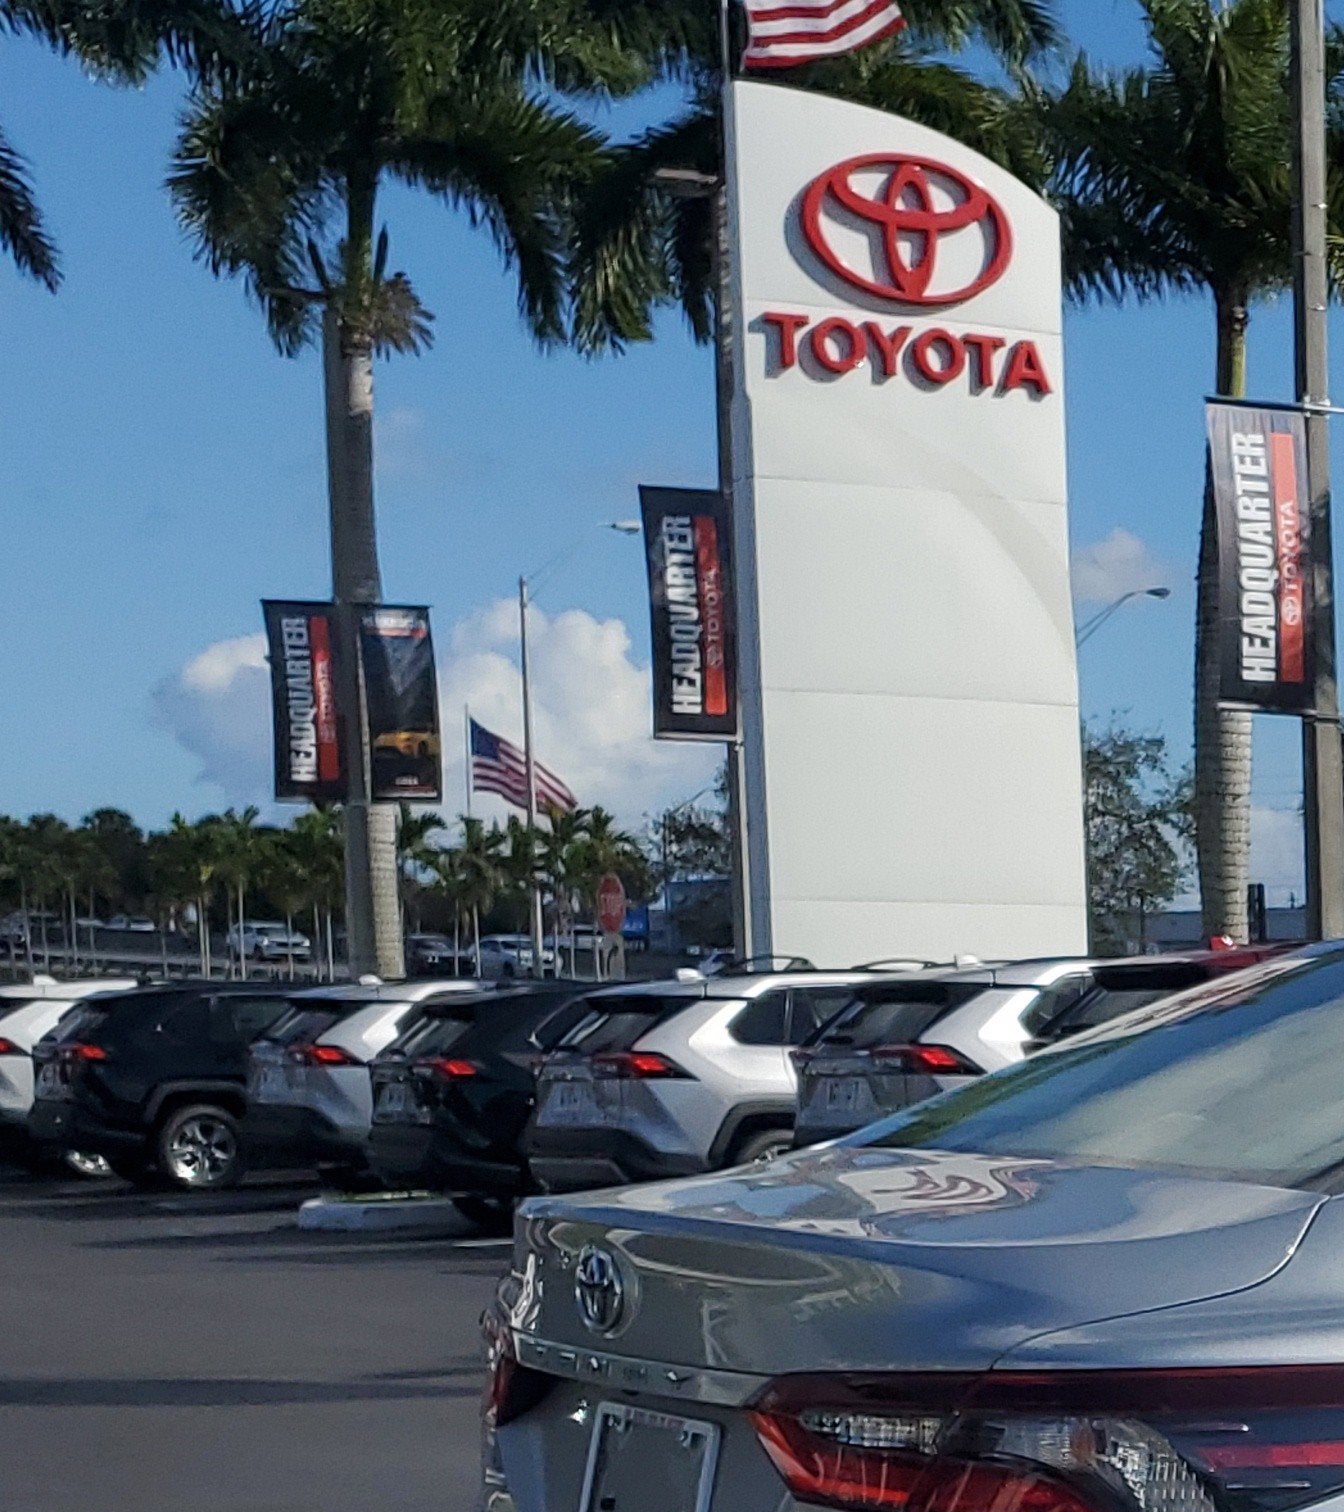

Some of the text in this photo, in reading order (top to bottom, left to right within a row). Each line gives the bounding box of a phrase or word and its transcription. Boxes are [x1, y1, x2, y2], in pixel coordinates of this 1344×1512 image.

[762, 310, 1052, 395] TOYOTA
[662, 515, 703, 715] HEADQUARTER
[704, 566, 724, 643] TOYOTA
[1231, 432, 1279, 682] HEADQUARTER
[1279, 501, 1303, 598] TOYOTA
[281, 616, 319, 782] HEADQUARTER
